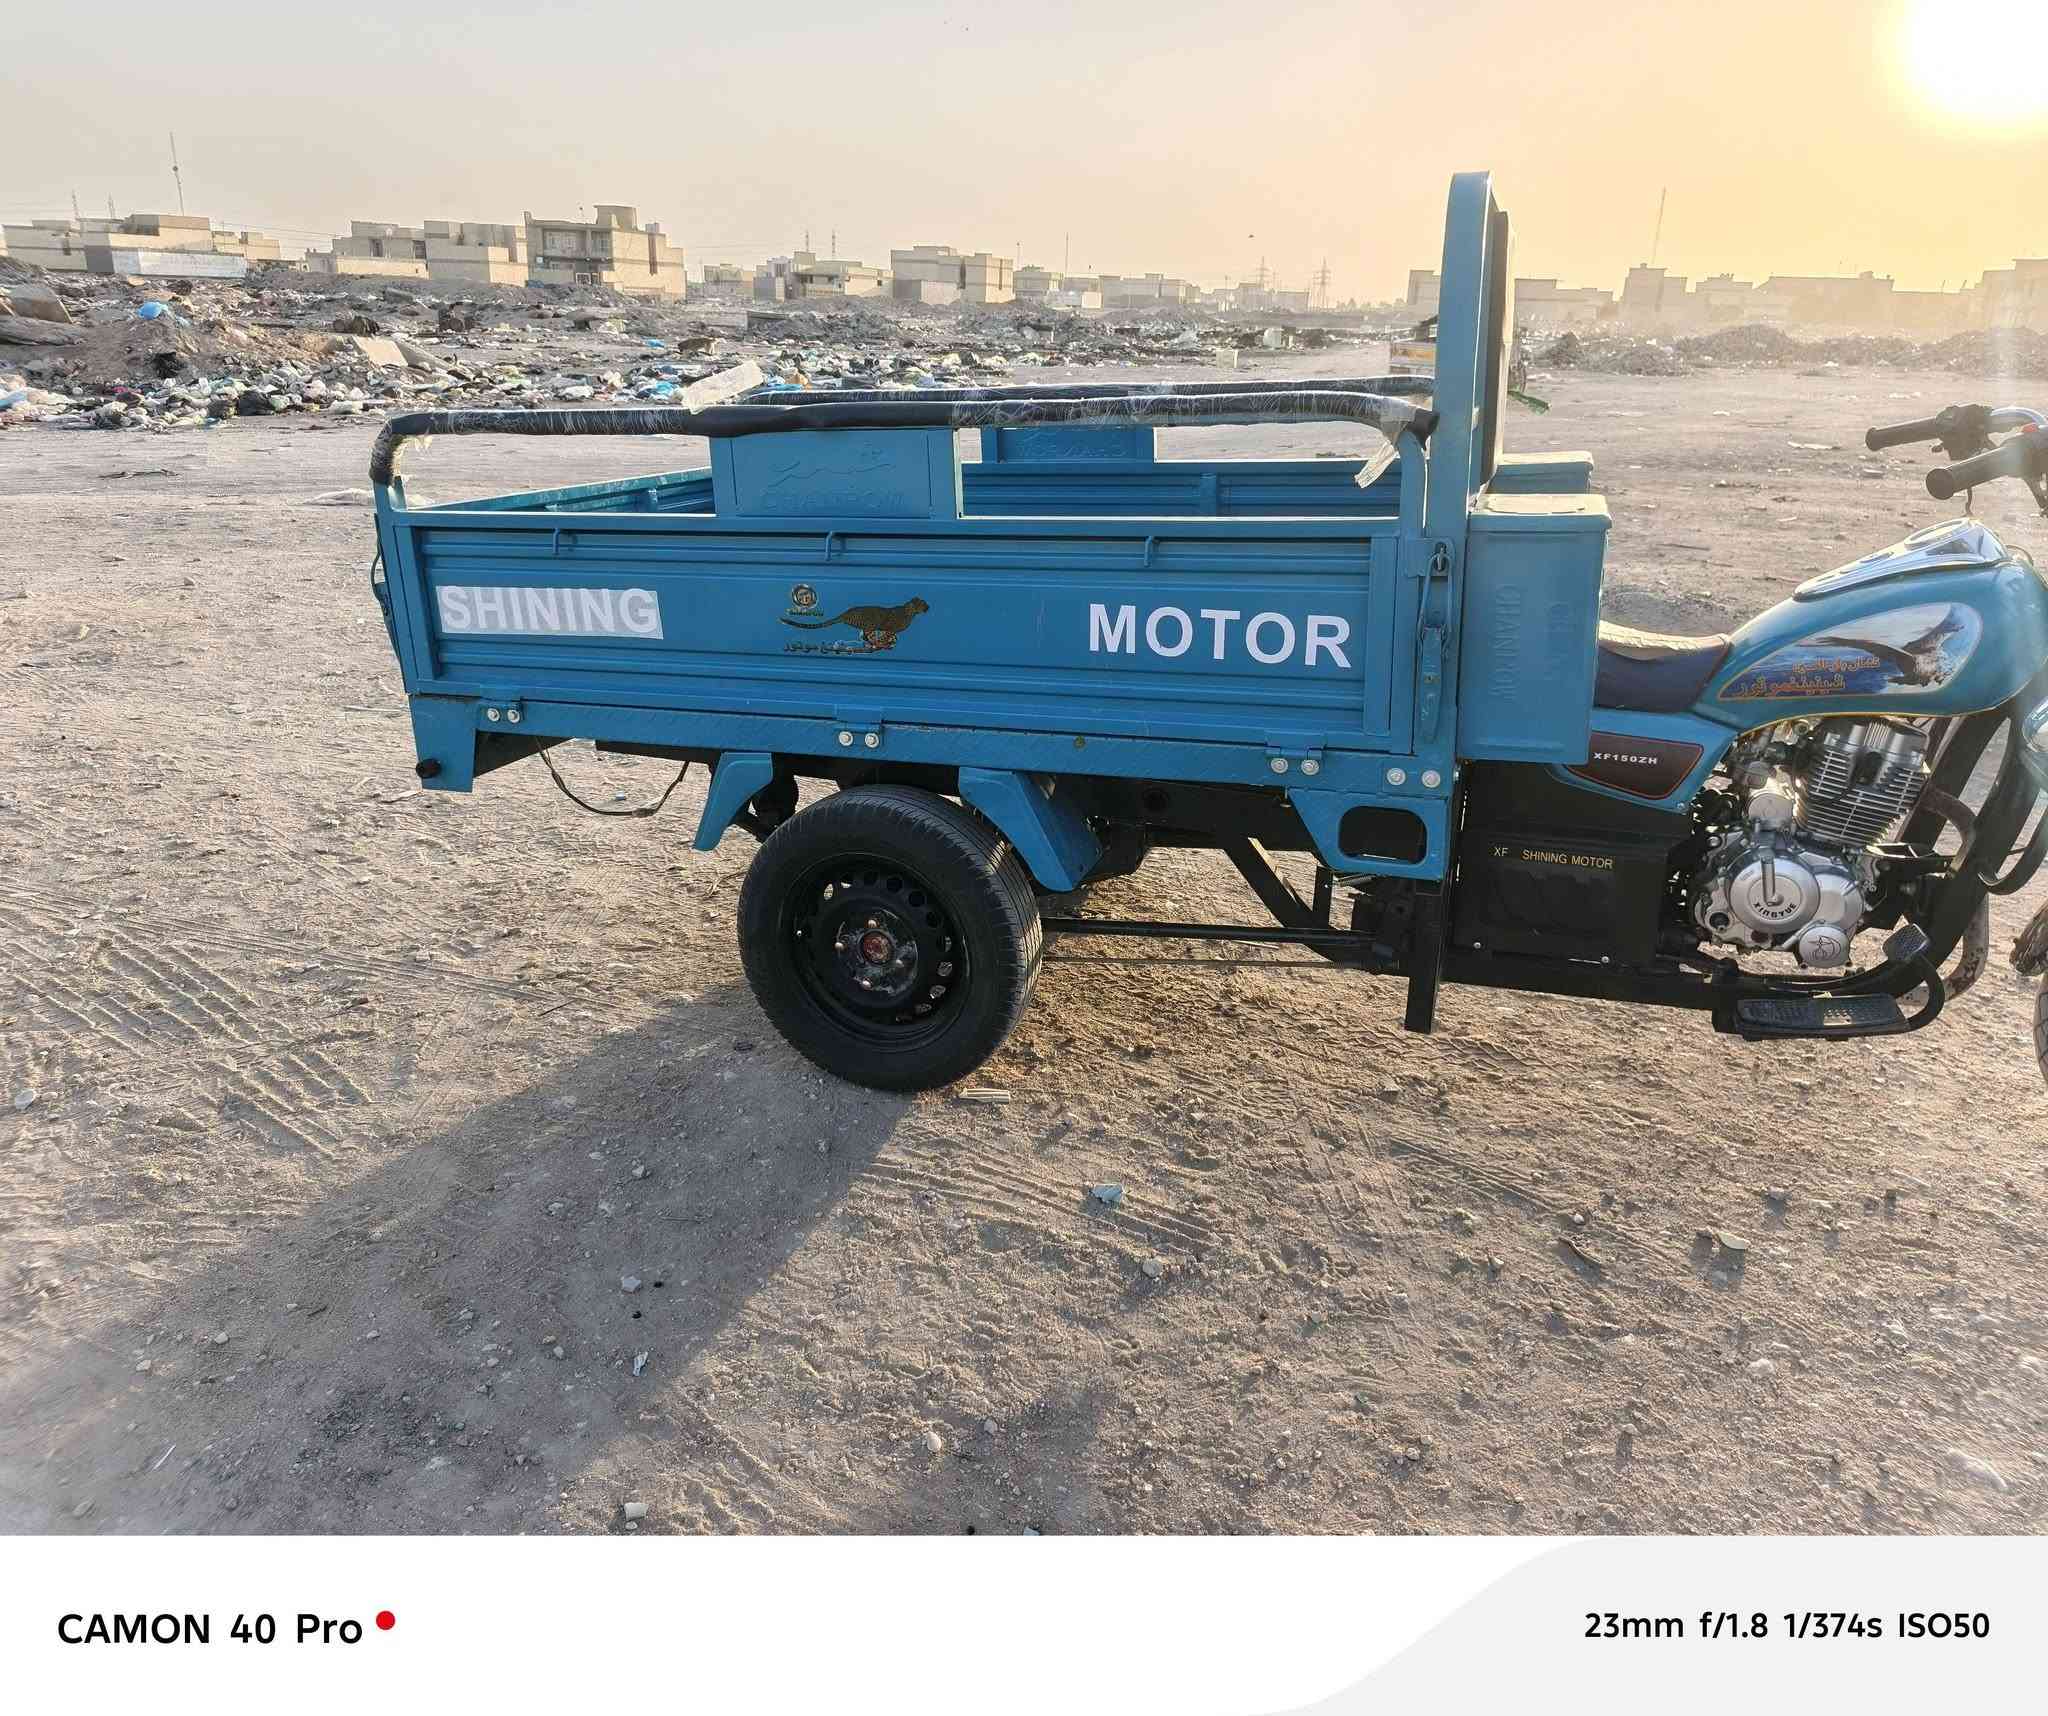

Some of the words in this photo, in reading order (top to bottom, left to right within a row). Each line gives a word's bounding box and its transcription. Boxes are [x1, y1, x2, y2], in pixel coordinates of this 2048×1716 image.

[440, 585, 659, 634] SHINING
[1089, 603, 1351, 668] MOTOR
[1593, 752, 1658, 765] XF150ZH
[1494, 847, 1509, 857] XF
[1522, 849, 1568, 865] SHINING
[1571, 855, 1613, 869] MOTOR
[1753, 901, 1797, 919] XINGYUE
